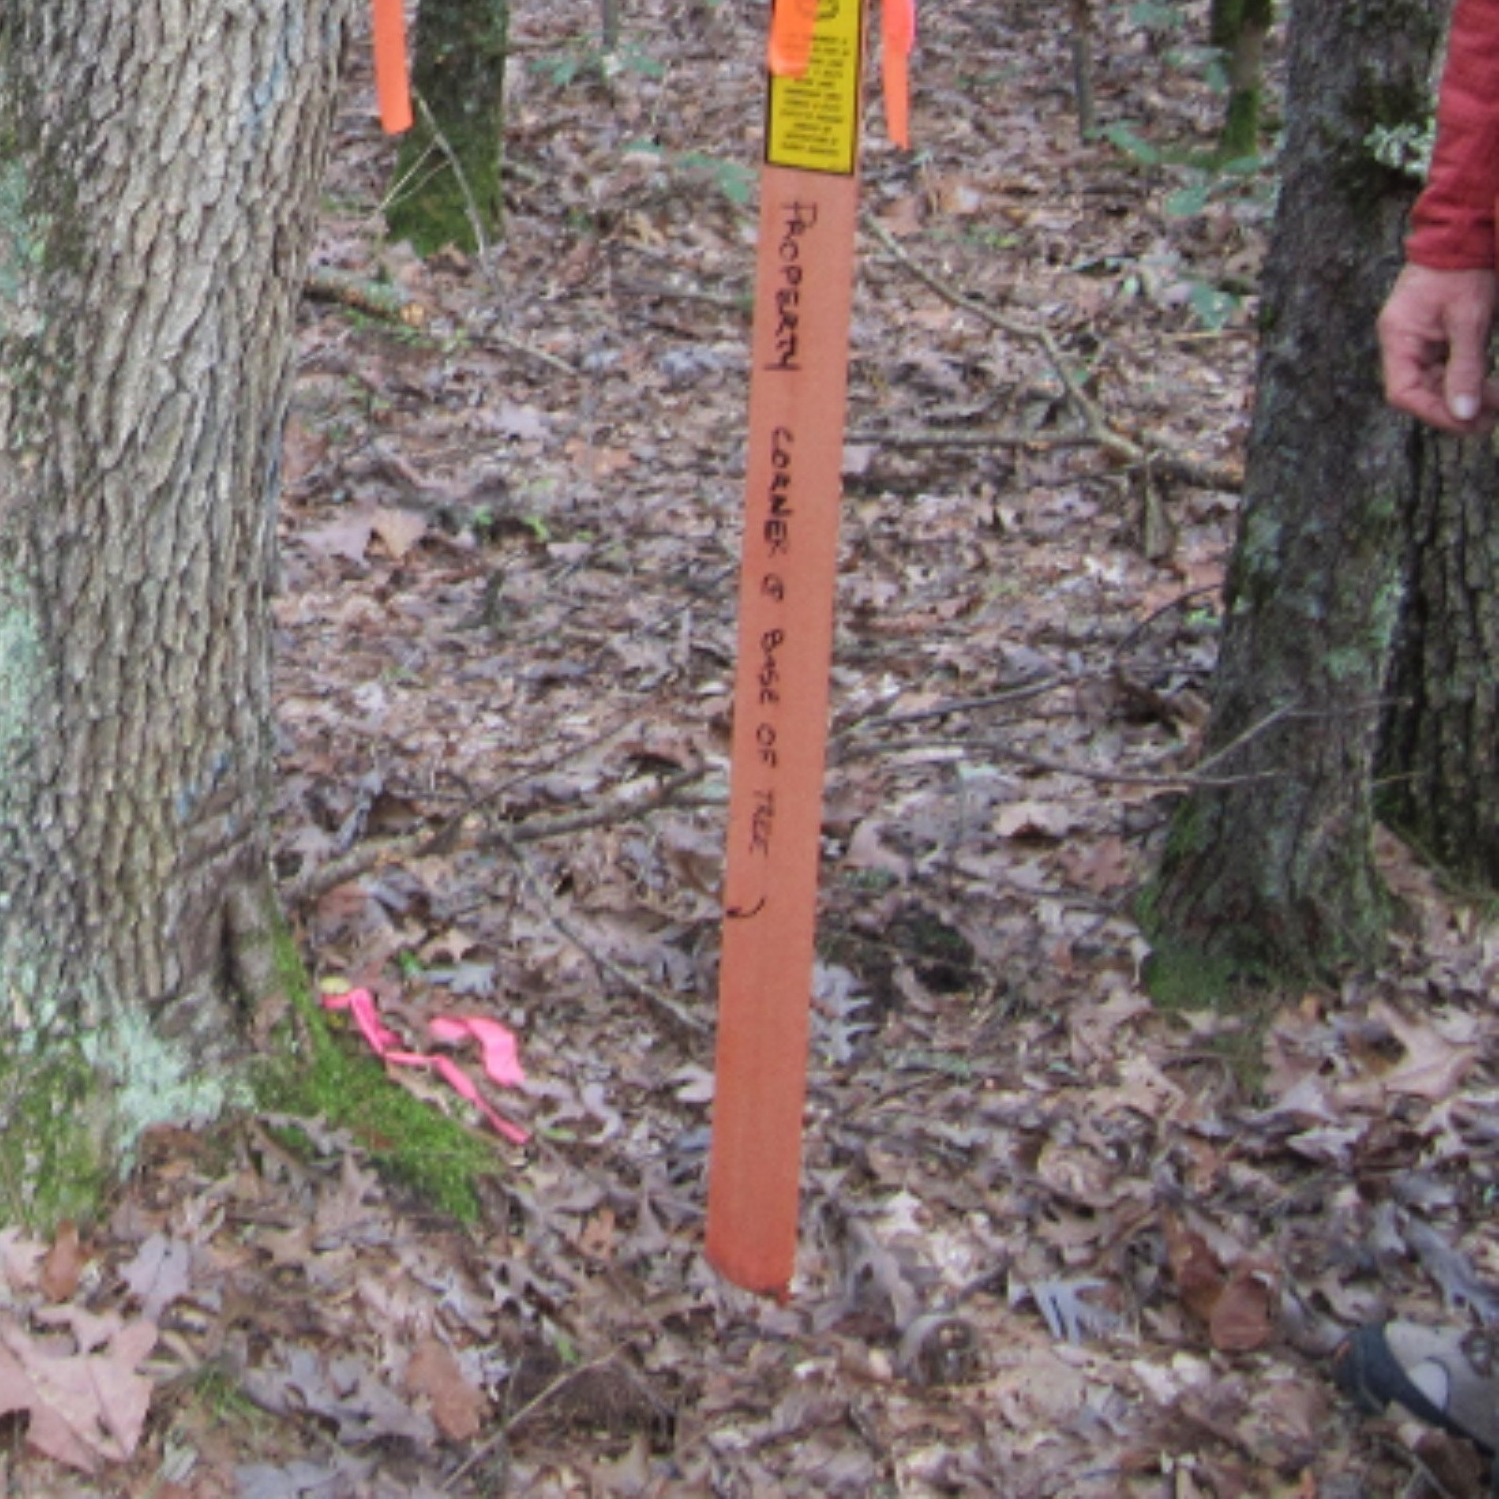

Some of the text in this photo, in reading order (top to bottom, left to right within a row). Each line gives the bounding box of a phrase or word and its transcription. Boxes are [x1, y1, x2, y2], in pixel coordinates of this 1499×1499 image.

[765, 200, 818, 371] PROPERTY
[763, 426, 796, 558] CORNER
[759, 627, 786, 706] BASE
[756, 723, 778, 768] OF
[749, 789, 776, 858] TREE
